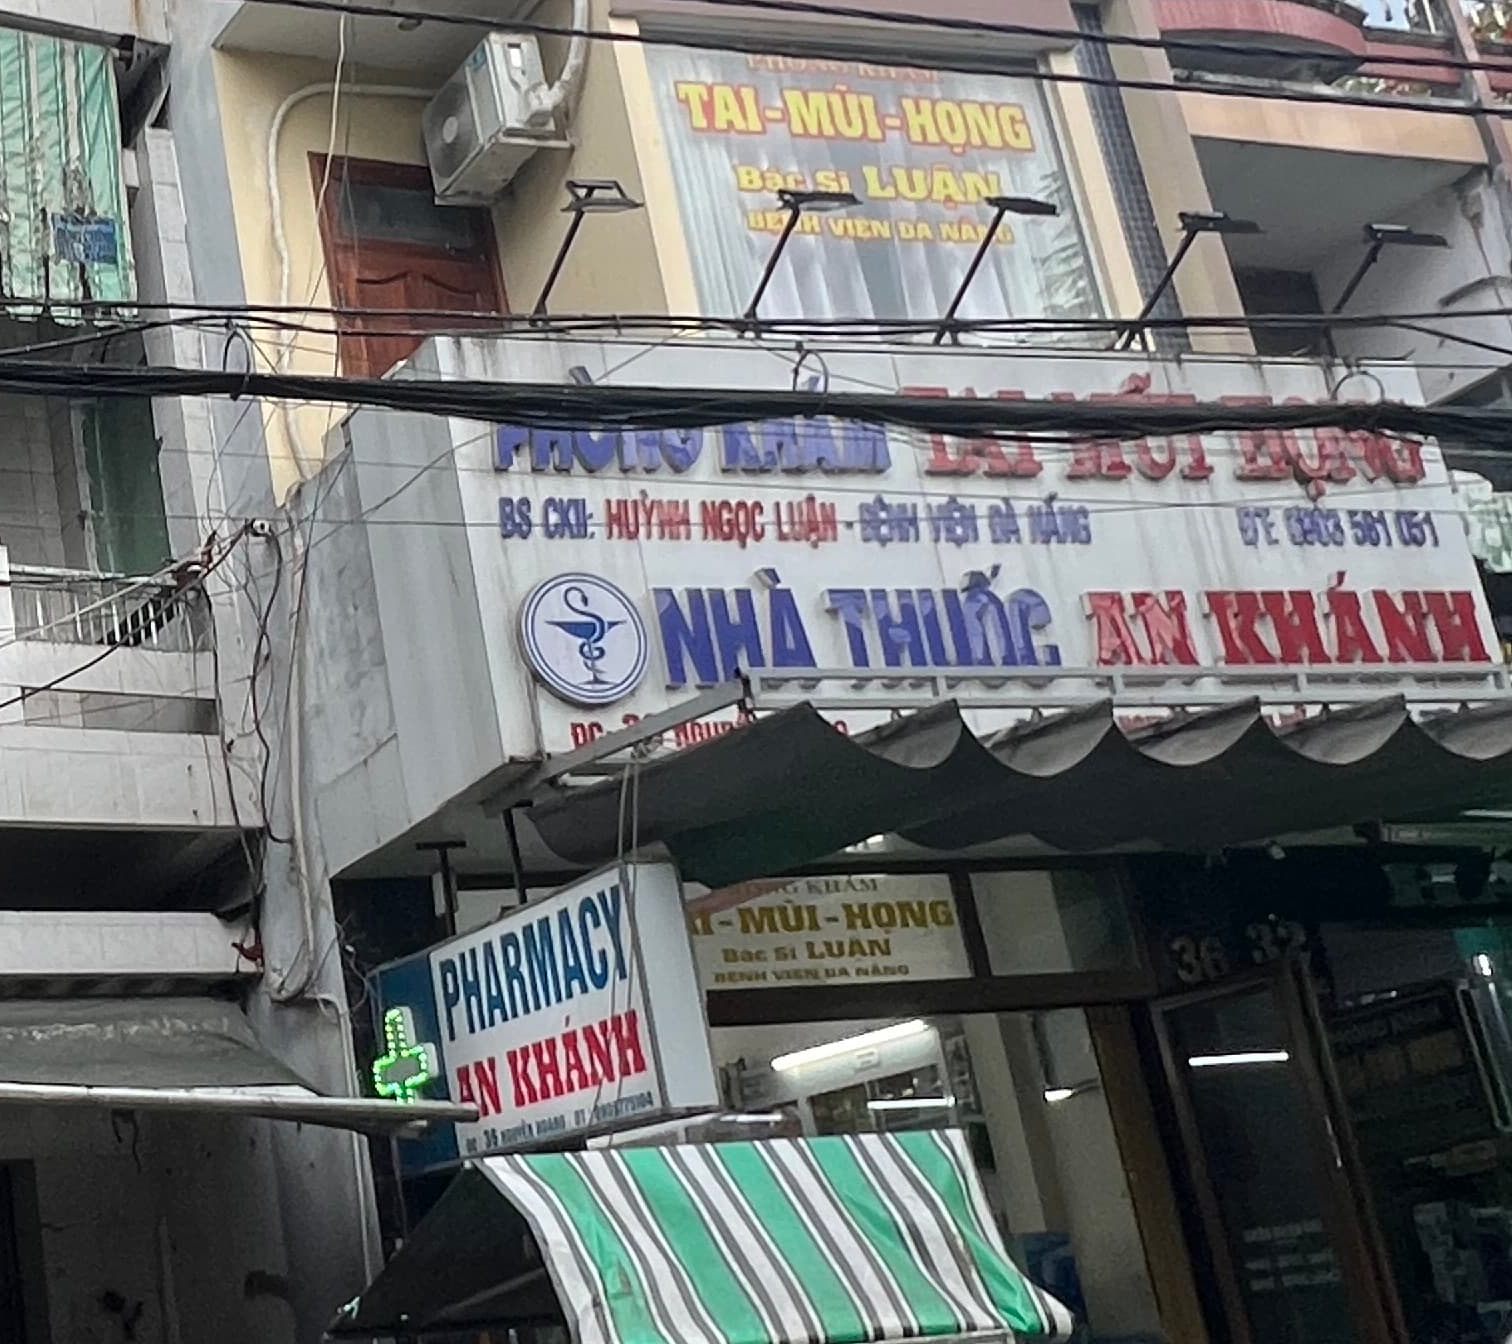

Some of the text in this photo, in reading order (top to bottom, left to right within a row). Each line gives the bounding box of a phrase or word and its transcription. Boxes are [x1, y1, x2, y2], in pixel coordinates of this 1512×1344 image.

[498, 495, 532, 540] BS
[701, 499, 765, 549] NGỌC
[774, 493, 838, 549] LUẬN
[651, 563, 1492, 687] NHÀ THUỐC AN KHÁNH
[439, 884, 628, 1042] PHARMACY
[456, 1056, 503, 1118] AN
[506, 1014, 648, 1108] KHÁNH
